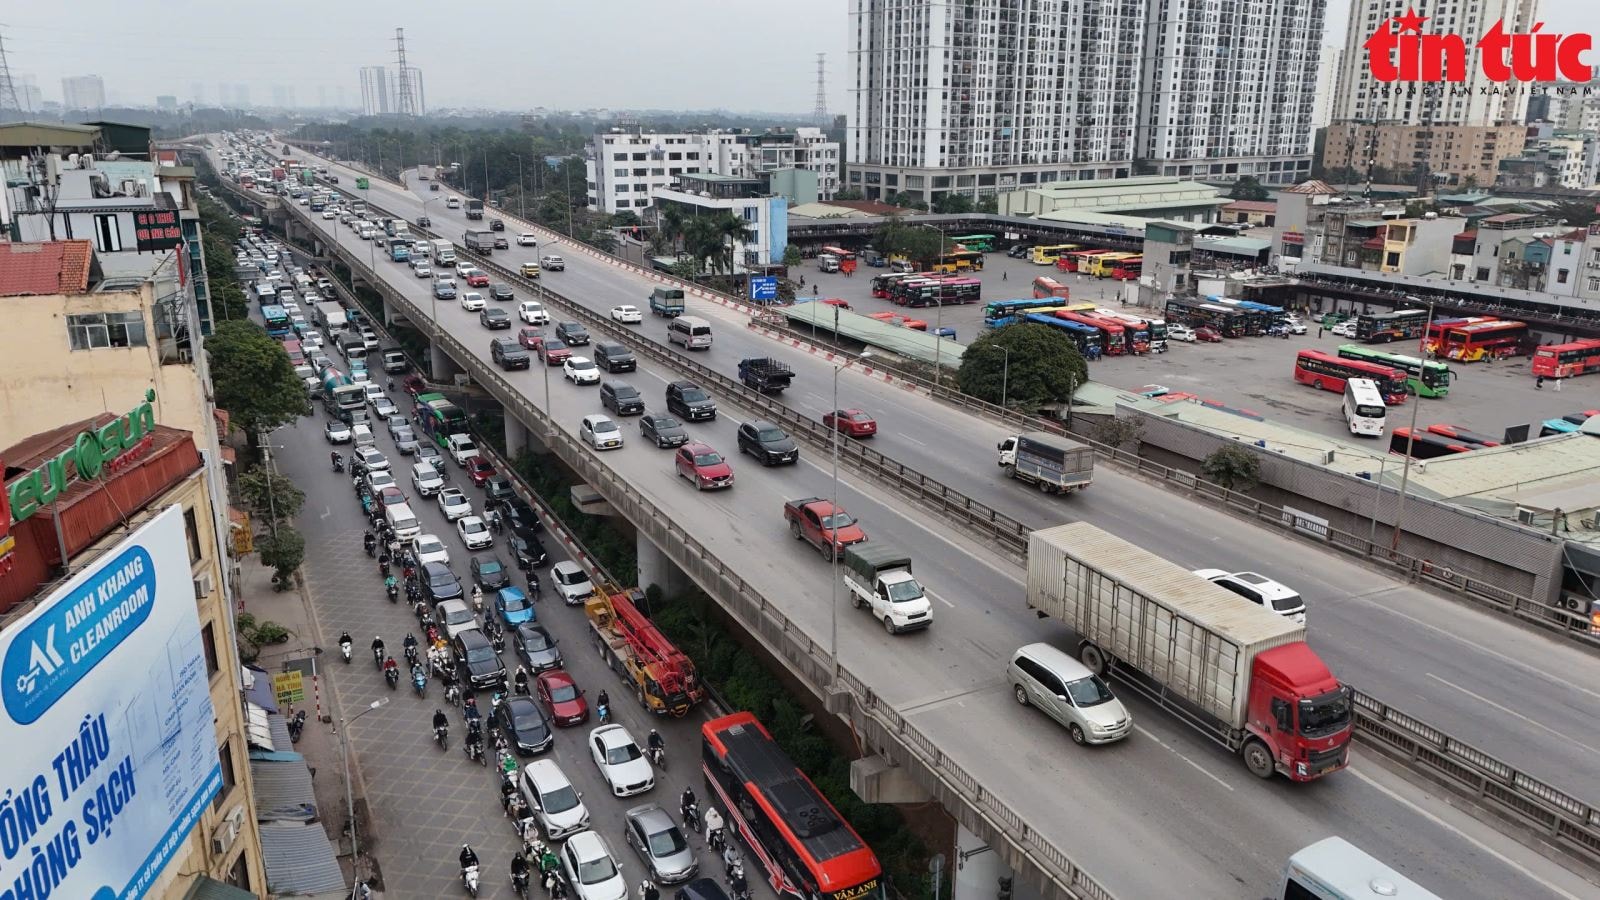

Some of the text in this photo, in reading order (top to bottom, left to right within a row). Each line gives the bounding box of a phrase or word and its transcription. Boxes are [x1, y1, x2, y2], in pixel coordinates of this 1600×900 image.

[65, 555, 144, 634] ANH KHANG
[69, 584, 149, 665] CLEANROOM
[0, 774, 52, 860] ỔNG
[52, 712, 110, 802] THẦU
[83, 755, 136, 845] SẠCH
[857, 880, 878, 895] ANH
